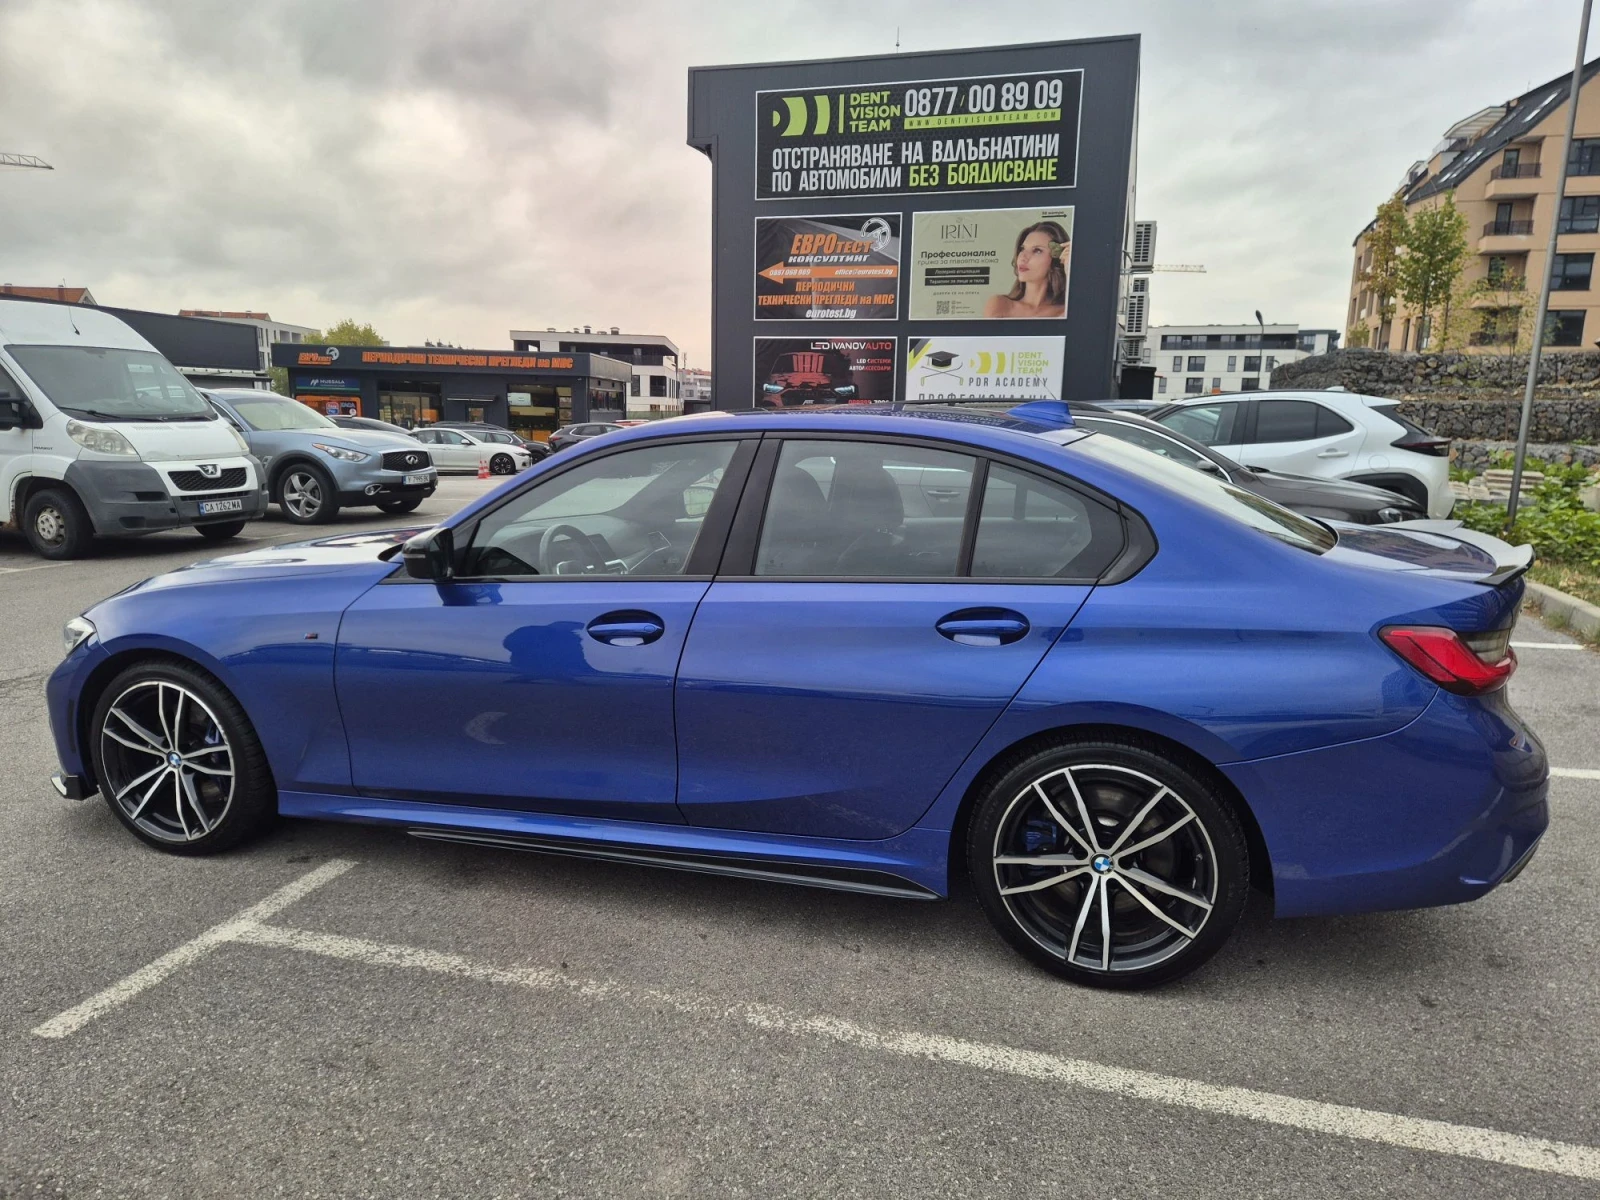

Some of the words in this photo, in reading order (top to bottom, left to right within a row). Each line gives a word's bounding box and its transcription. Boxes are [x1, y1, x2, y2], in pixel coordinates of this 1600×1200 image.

[849, 91, 891, 105] DENT
[905, 87, 958, 116] 0877
[968, 84, 996, 113] 00
[1001, 81, 1029, 111] 89
[1034, 79, 1063, 109] 09
[849, 105, 901, 118] VISION
[849, 119, 891, 133] TEAM
[772, 143, 893, 170] ОТСТРАНЯВАНЕ
[901, 141, 924, 164] НА
[932, 133, 1060, 162] ВДЛЪБНАТИНИ
[772, 171, 791, 192] ПО
[799, 166, 901, 192] АВТОМОБИЛИ
[909, 164, 939, 187] БЕЗ
[947, 158, 1058, 185] БОЯДИСВАНЕ
[941, 223, 978, 239] IRINI
[921, 250, 997, 259] Професионална
[795, 281, 855, 293] ПЕРИОДИЧНИ
[758, 295, 812, 306] ТЕХНИЧЕСКИ
[815, 294, 858, 306] ПРЕГЛЕДИ
[873, 293, 895, 305] МПС
[805, 308, 857, 319] eurotest.bg
[968, 377, 989, 387] PDR
[995, 377, 1048, 387] ACADEMY
[204, 503, 214, 512] CA
[215, 502, 231, 510] 1262
